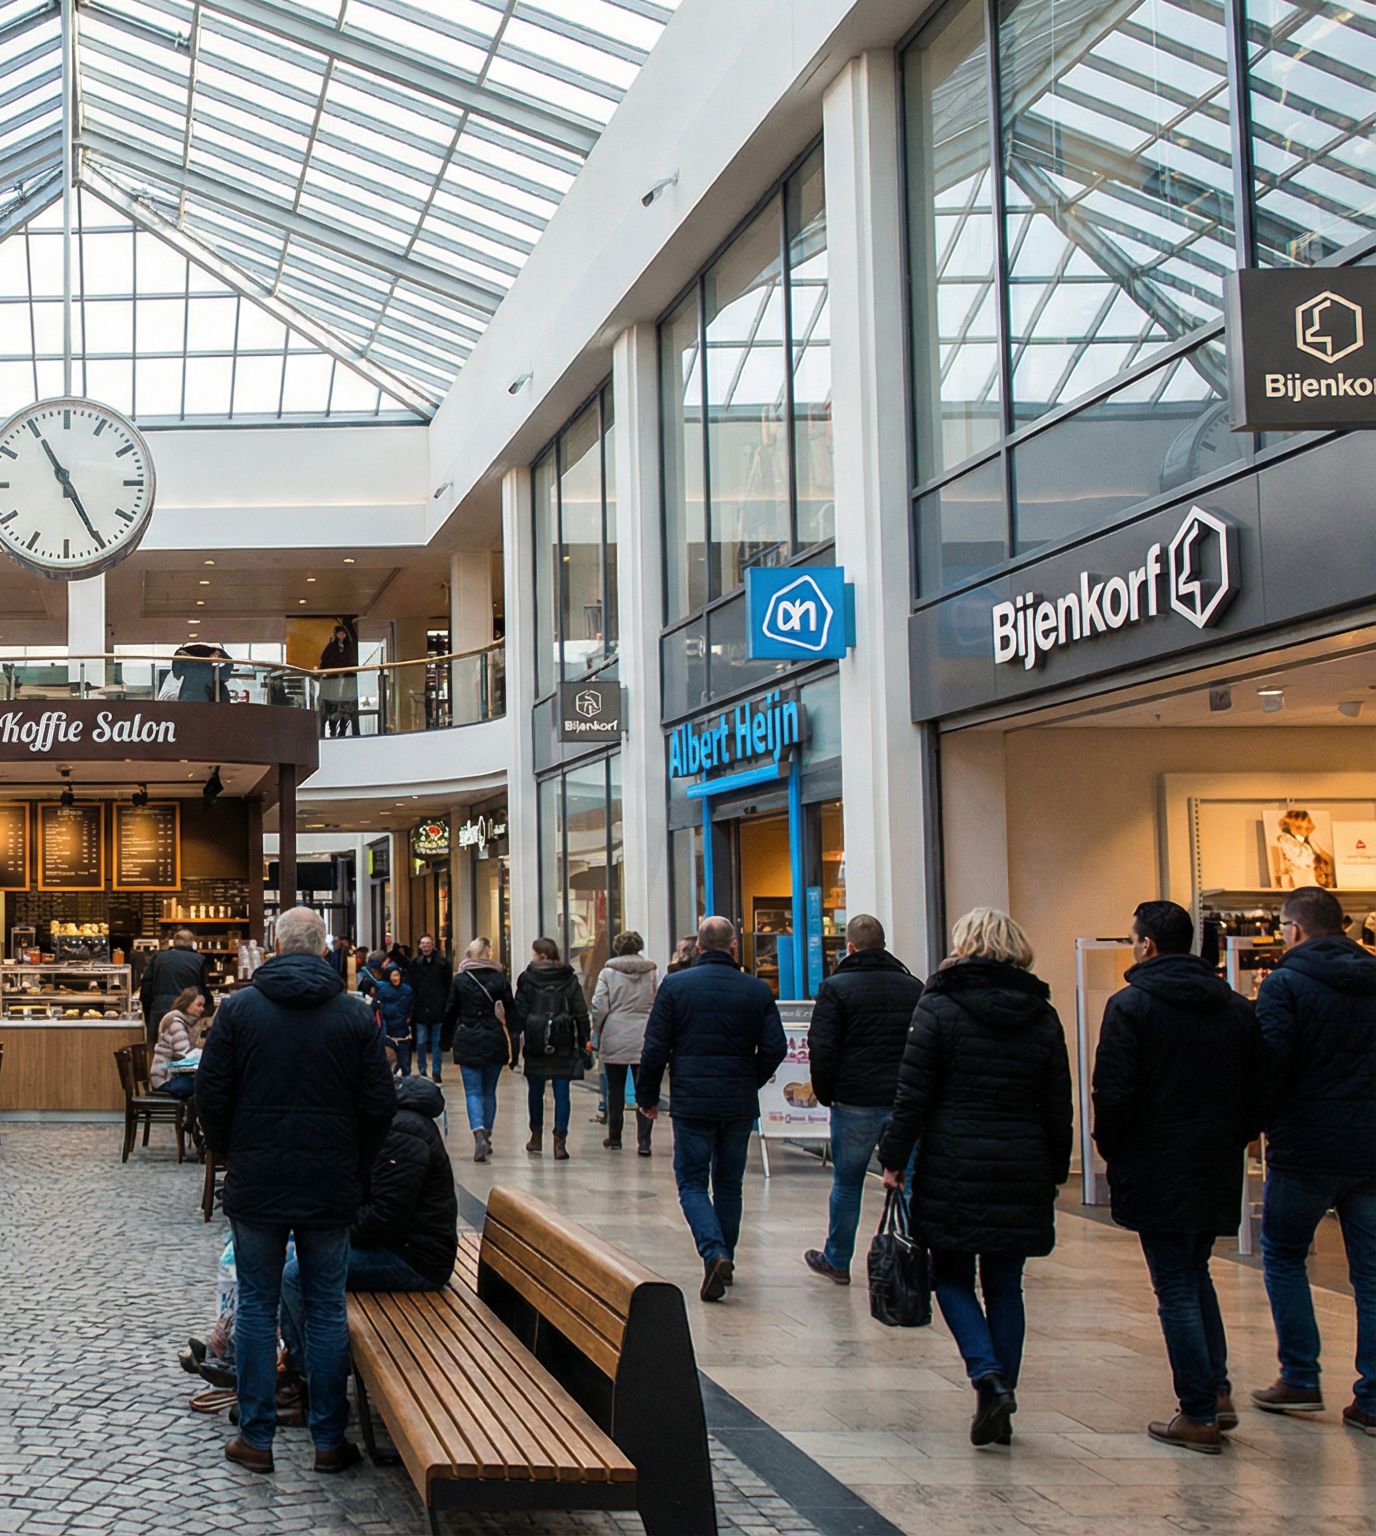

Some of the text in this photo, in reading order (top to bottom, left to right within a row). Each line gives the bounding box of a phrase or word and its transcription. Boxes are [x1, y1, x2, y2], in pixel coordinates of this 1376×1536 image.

[1265, 373, 1376, 402] Bijenko
[992, 543, 1161, 671] Bijenkorf
[92, 711, 176, 743] Salon
[669, 688, 799, 779] Albert Heijn
